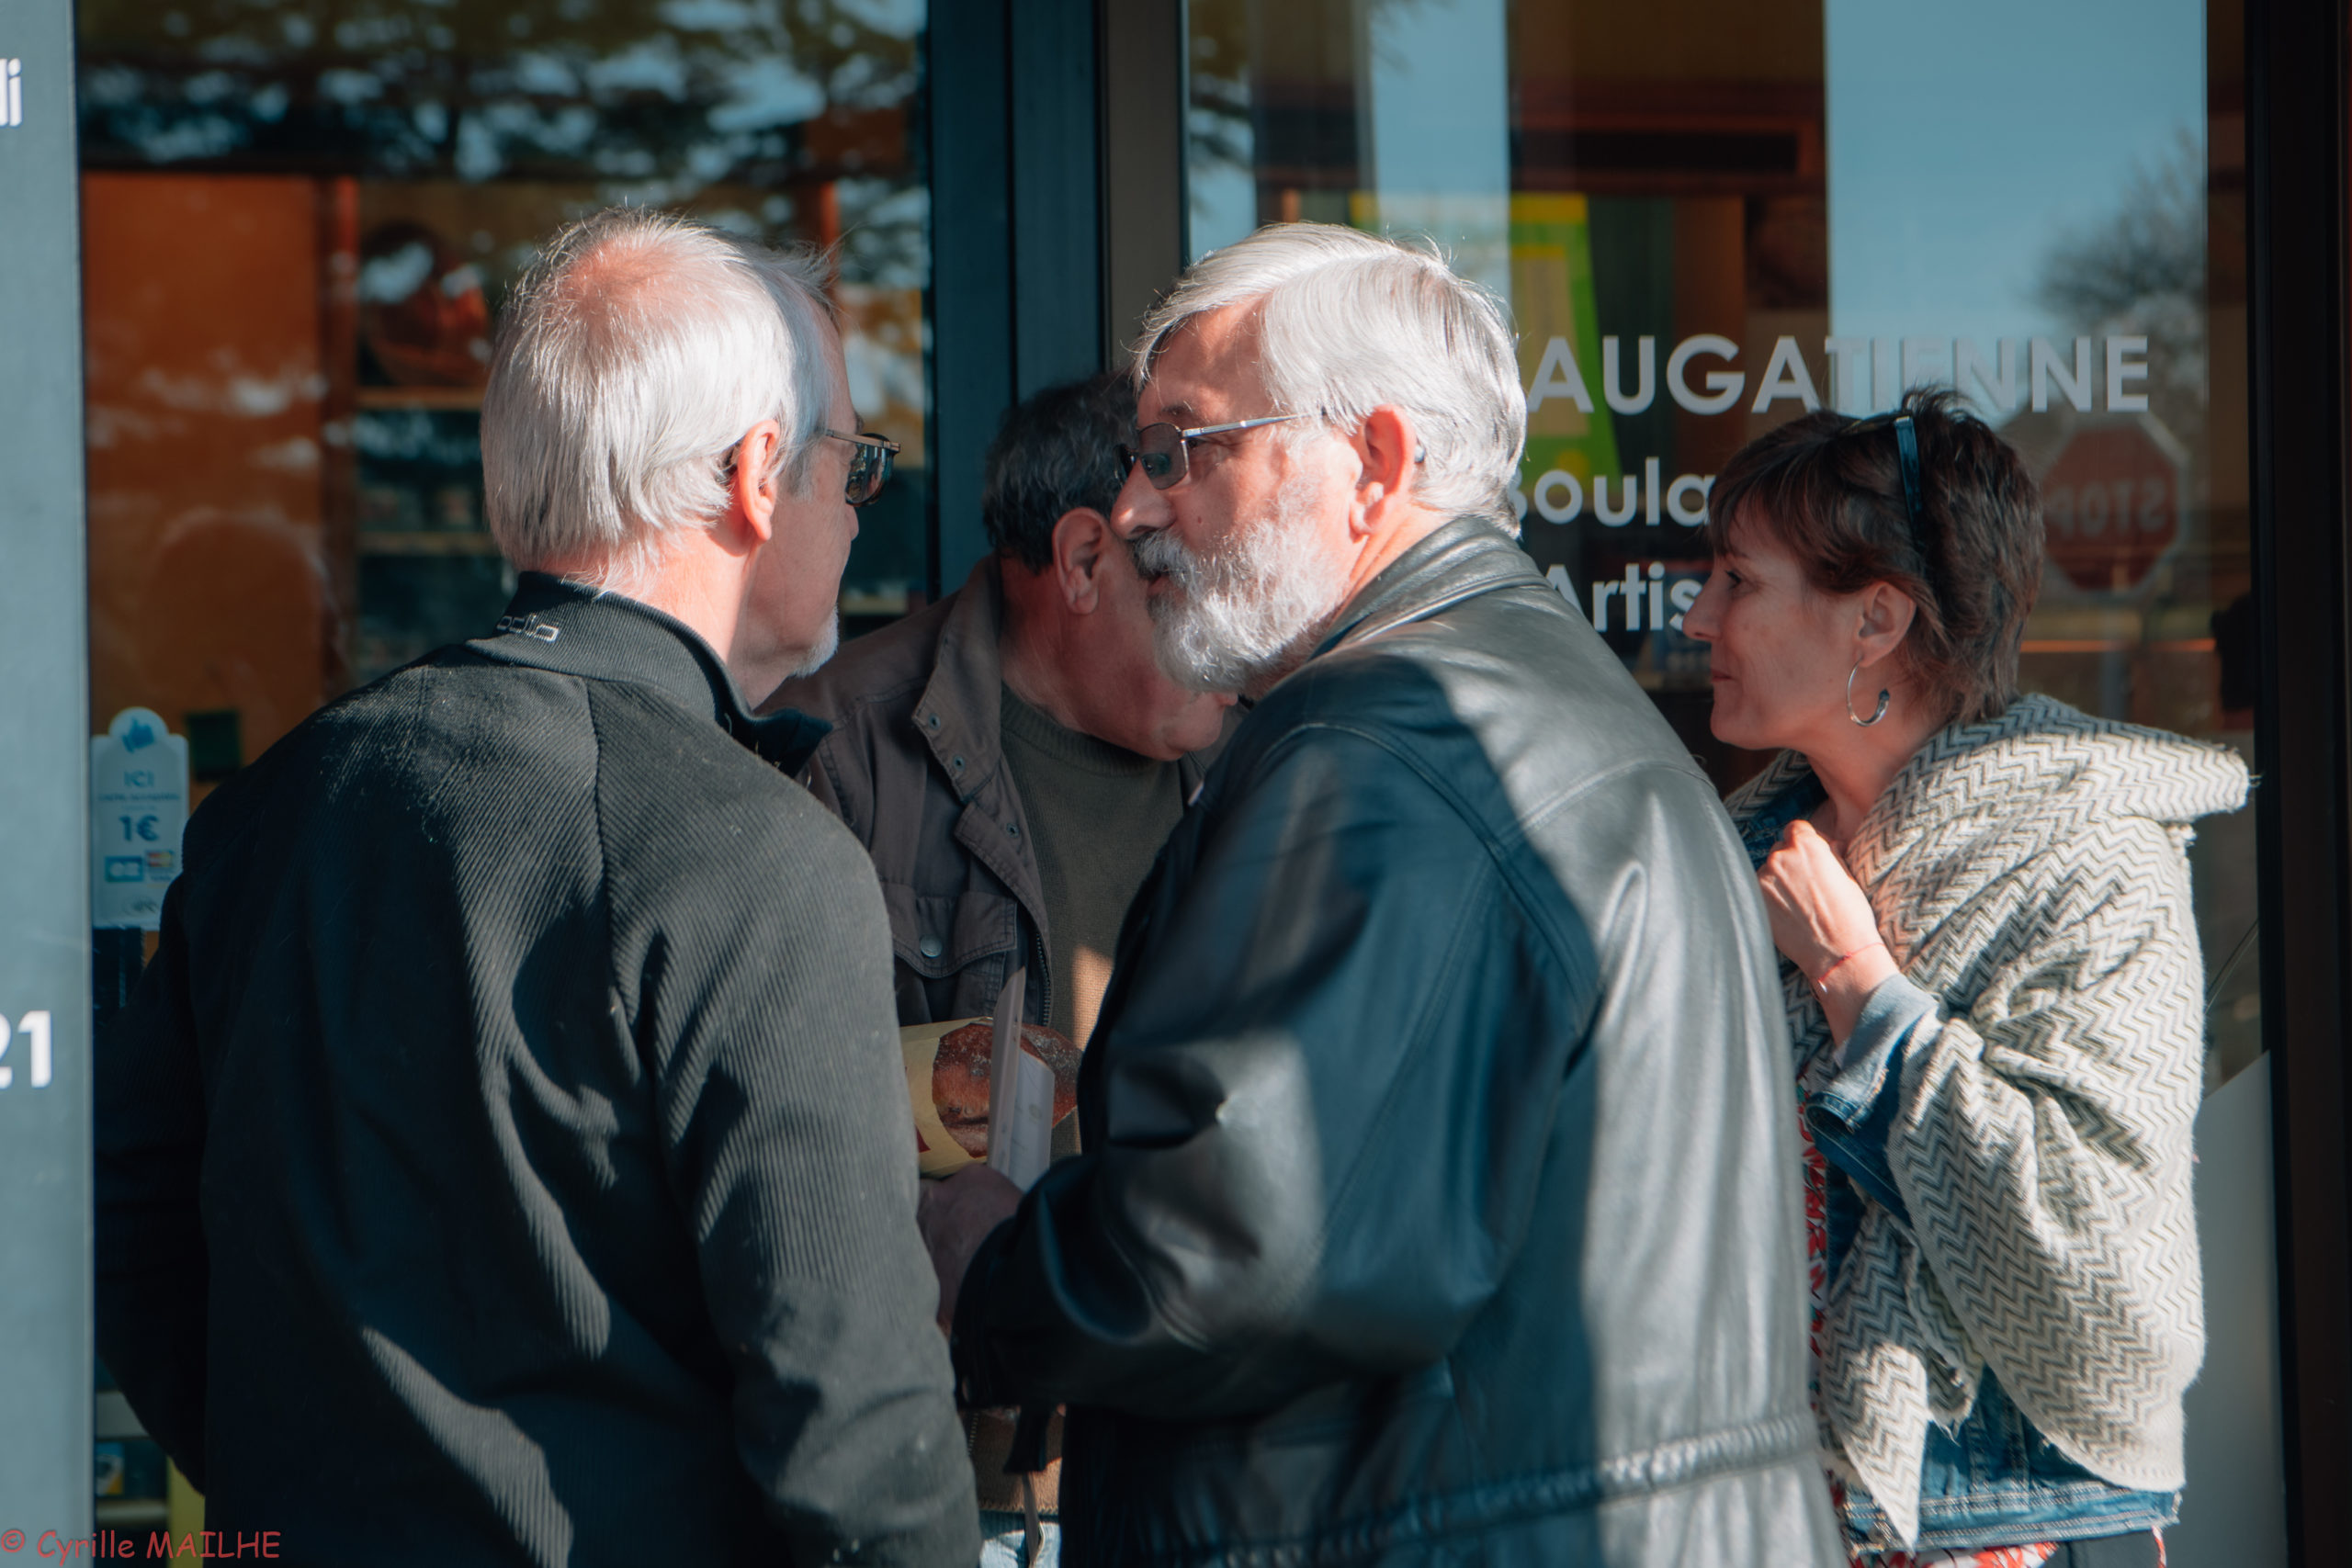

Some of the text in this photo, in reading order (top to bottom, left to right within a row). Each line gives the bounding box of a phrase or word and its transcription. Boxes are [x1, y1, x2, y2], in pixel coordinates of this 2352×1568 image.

[0, 58, 22, 127] i
[1527, 333, 2149, 415] AUGATIENNE
[119, 814, 160, 842] 1€
